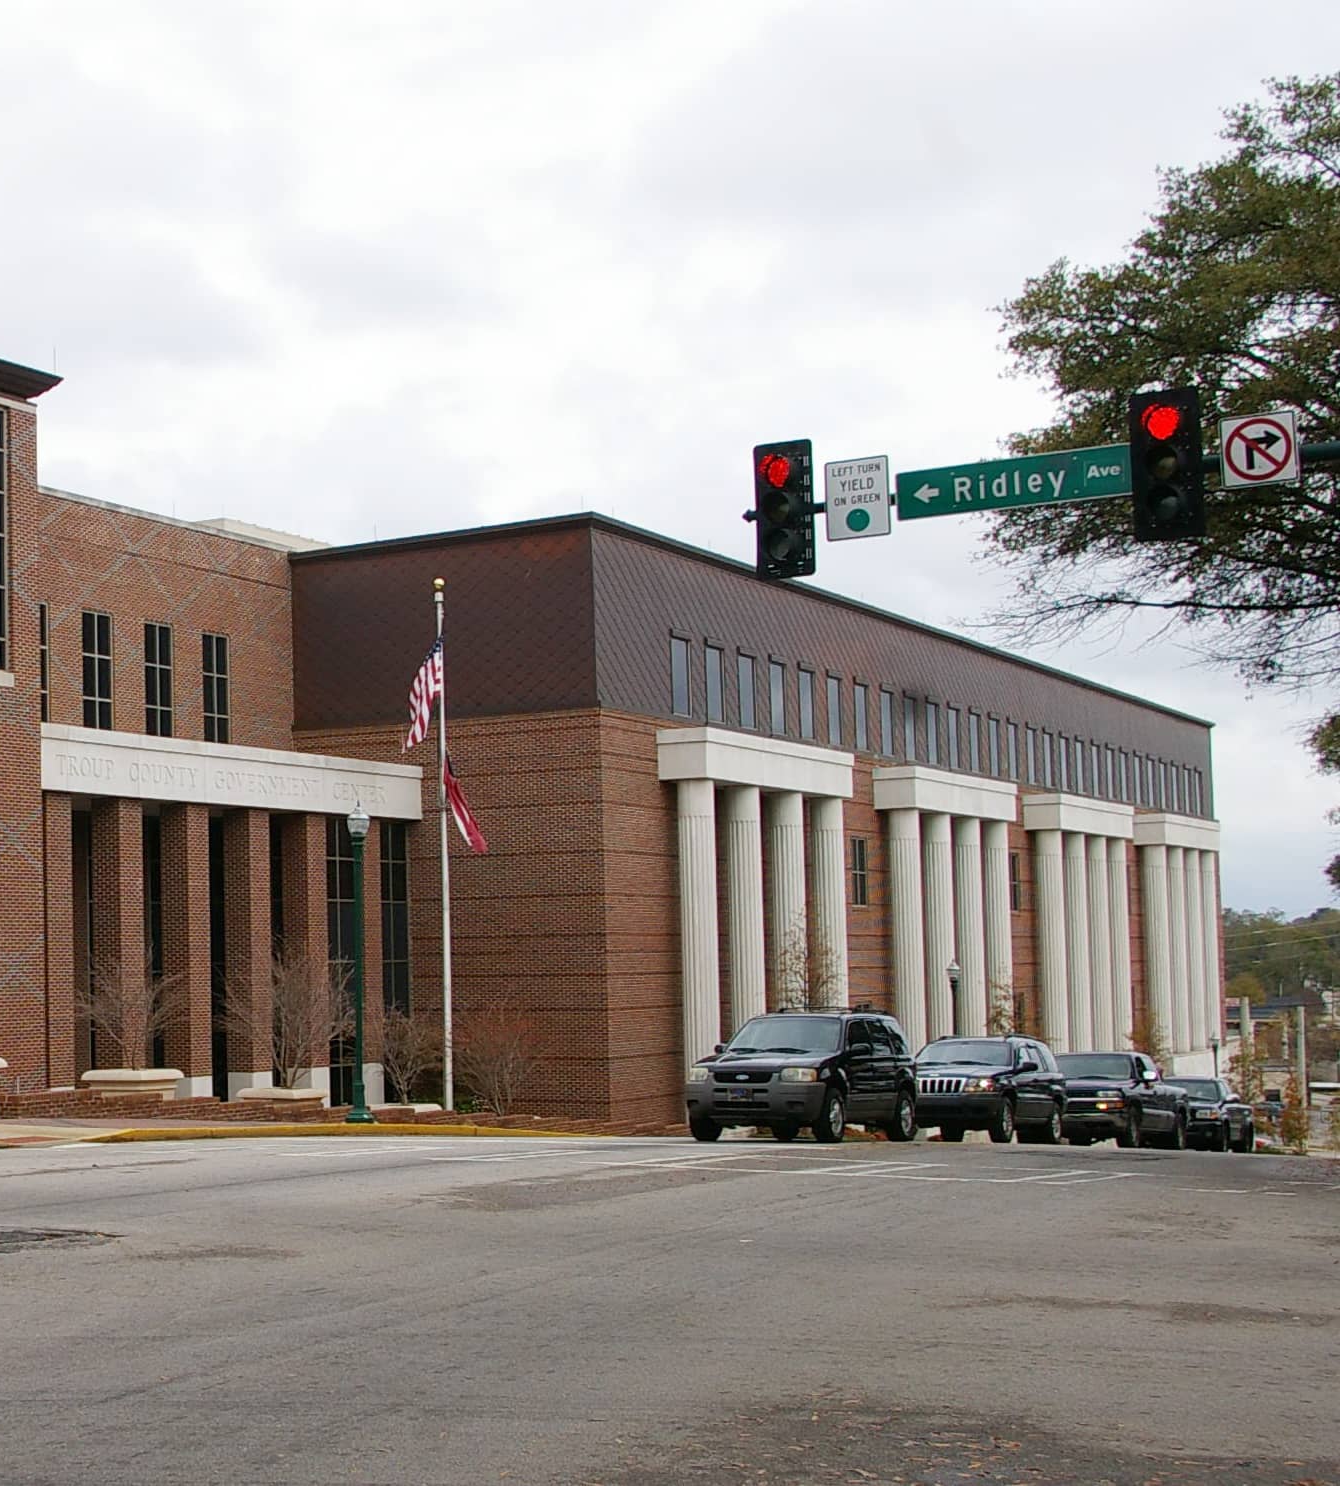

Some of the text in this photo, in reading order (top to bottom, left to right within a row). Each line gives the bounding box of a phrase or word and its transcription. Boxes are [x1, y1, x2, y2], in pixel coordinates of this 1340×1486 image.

[832, 462, 881, 477] LEFT TURN
[840, 477, 874, 491] YIELD
[954, 464, 1121, 502] Ridley Ave
[834, 493, 880, 506] ON GREEN
[56, 754, 387, 803] TROUP COUNTY GOVERNMENT CENTER
